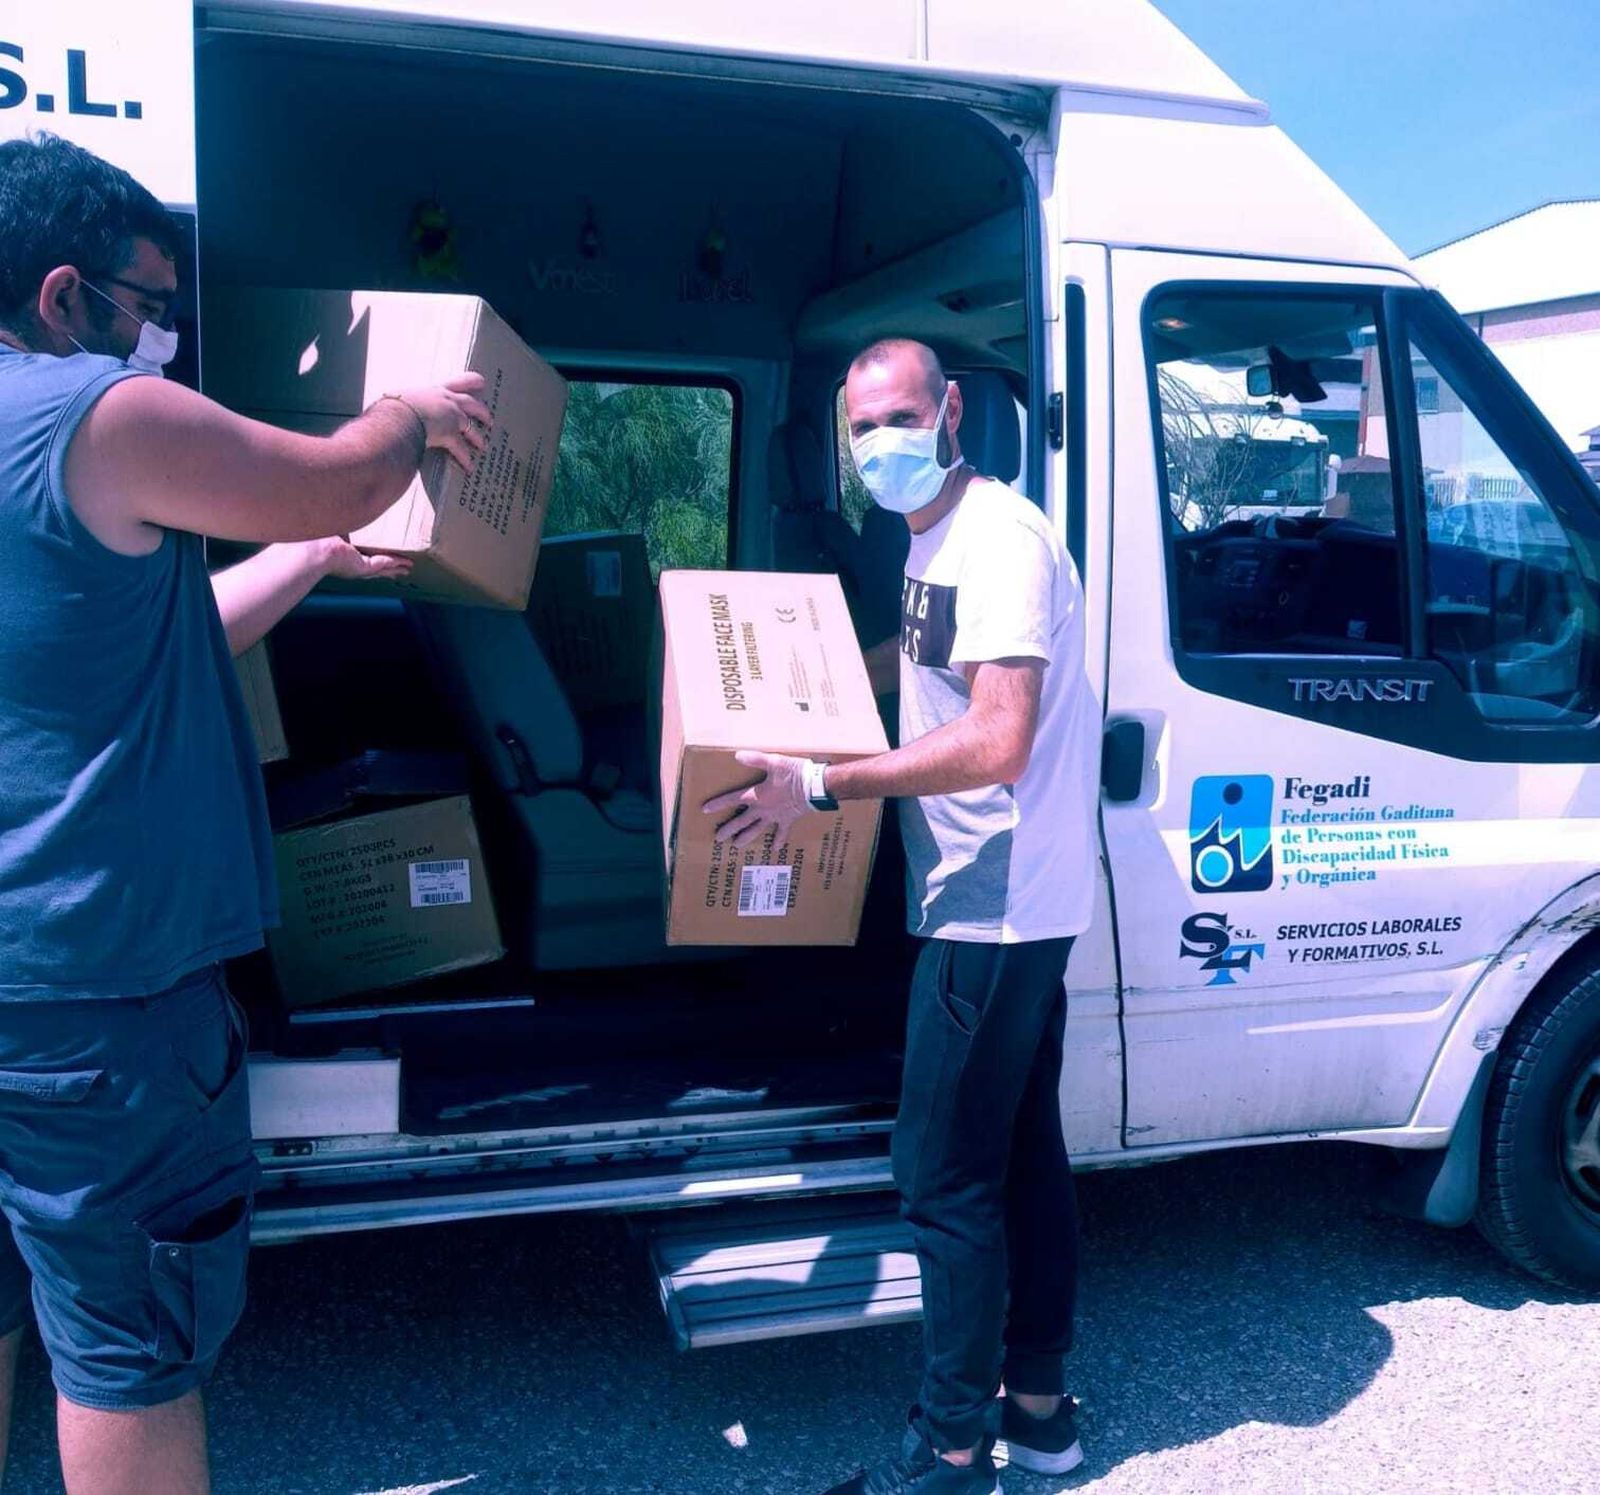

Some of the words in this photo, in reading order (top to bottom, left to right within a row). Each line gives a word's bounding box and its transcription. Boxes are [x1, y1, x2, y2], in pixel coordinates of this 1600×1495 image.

[0, 41, 142, 119] S.L.
[708, 593, 731, 621] MASK
[714, 622, 735, 646] FACE
[741, 621, 758, 654] FILTERING
[746, 654, 762, 675] LAYER
[717, 647, 747, 711] DISPOSABLE
[1287, 678, 1435, 702] TRANSIT
[1284, 776, 1371, 806] Fegadi
[1281, 807, 1375, 824] Federación
[1381, 804, 1455, 820] Gaditana
[1281, 829, 1302, 844] de
[1307, 826, 1382, 843] Personas
[1387, 828, 1417, 840] con
[1282, 846, 1397, 868] Discapacidad
[1401, 843, 1449, 860] Física
[1281, 872, 1292, 890] y
[1296, 868, 1377, 888] Orgánica
[1276, 920, 1369, 941] SERVICIOS
[1371, 916, 1463, 936] LABORALES
[1288, 948, 1299, 963] Y
[1302, 942, 1412, 963] FORMATIVOS,
[1416, 941, 1444, 956] S.L.
